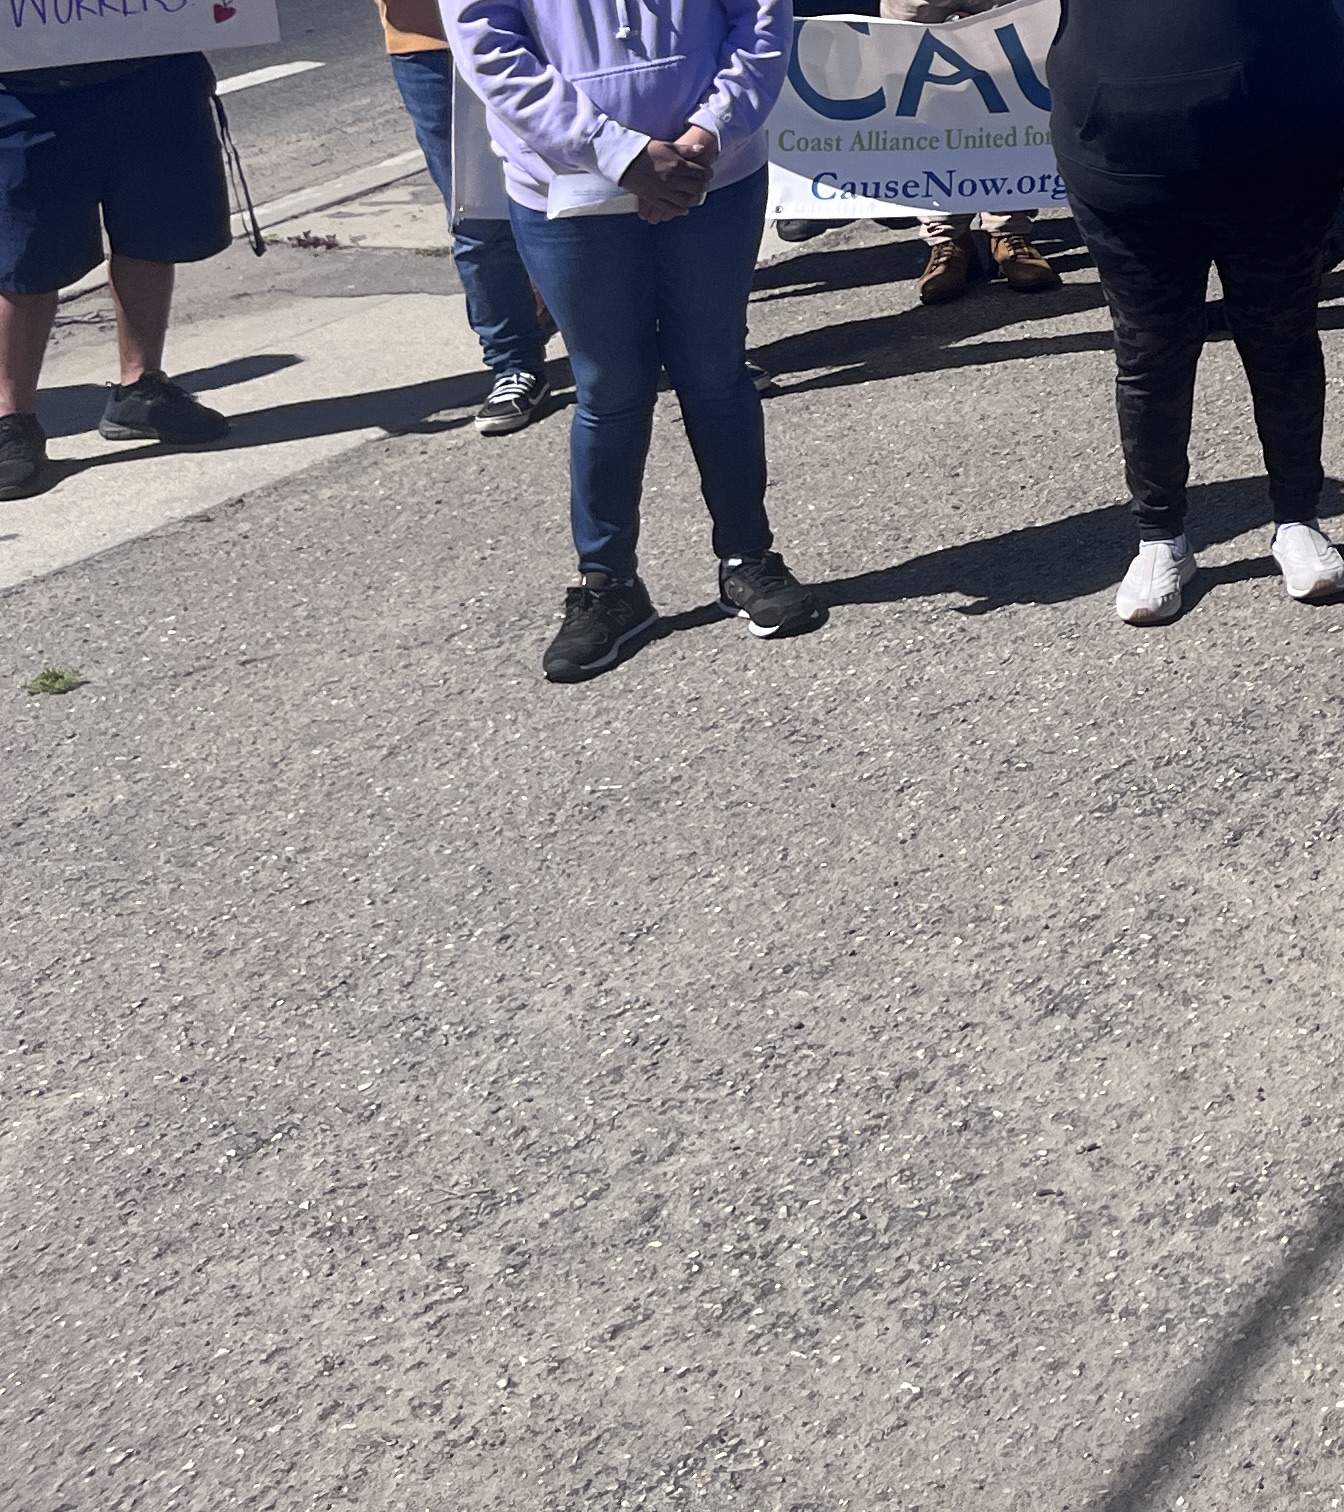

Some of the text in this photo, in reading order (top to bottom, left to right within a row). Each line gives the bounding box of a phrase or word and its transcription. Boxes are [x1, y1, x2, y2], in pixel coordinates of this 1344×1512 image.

[787, 20, 1053, 121] CAU
[777, 129, 842, 152] Coast
[849, 129, 940, 152] Alliance
[945, 126, 1018, 150] United
